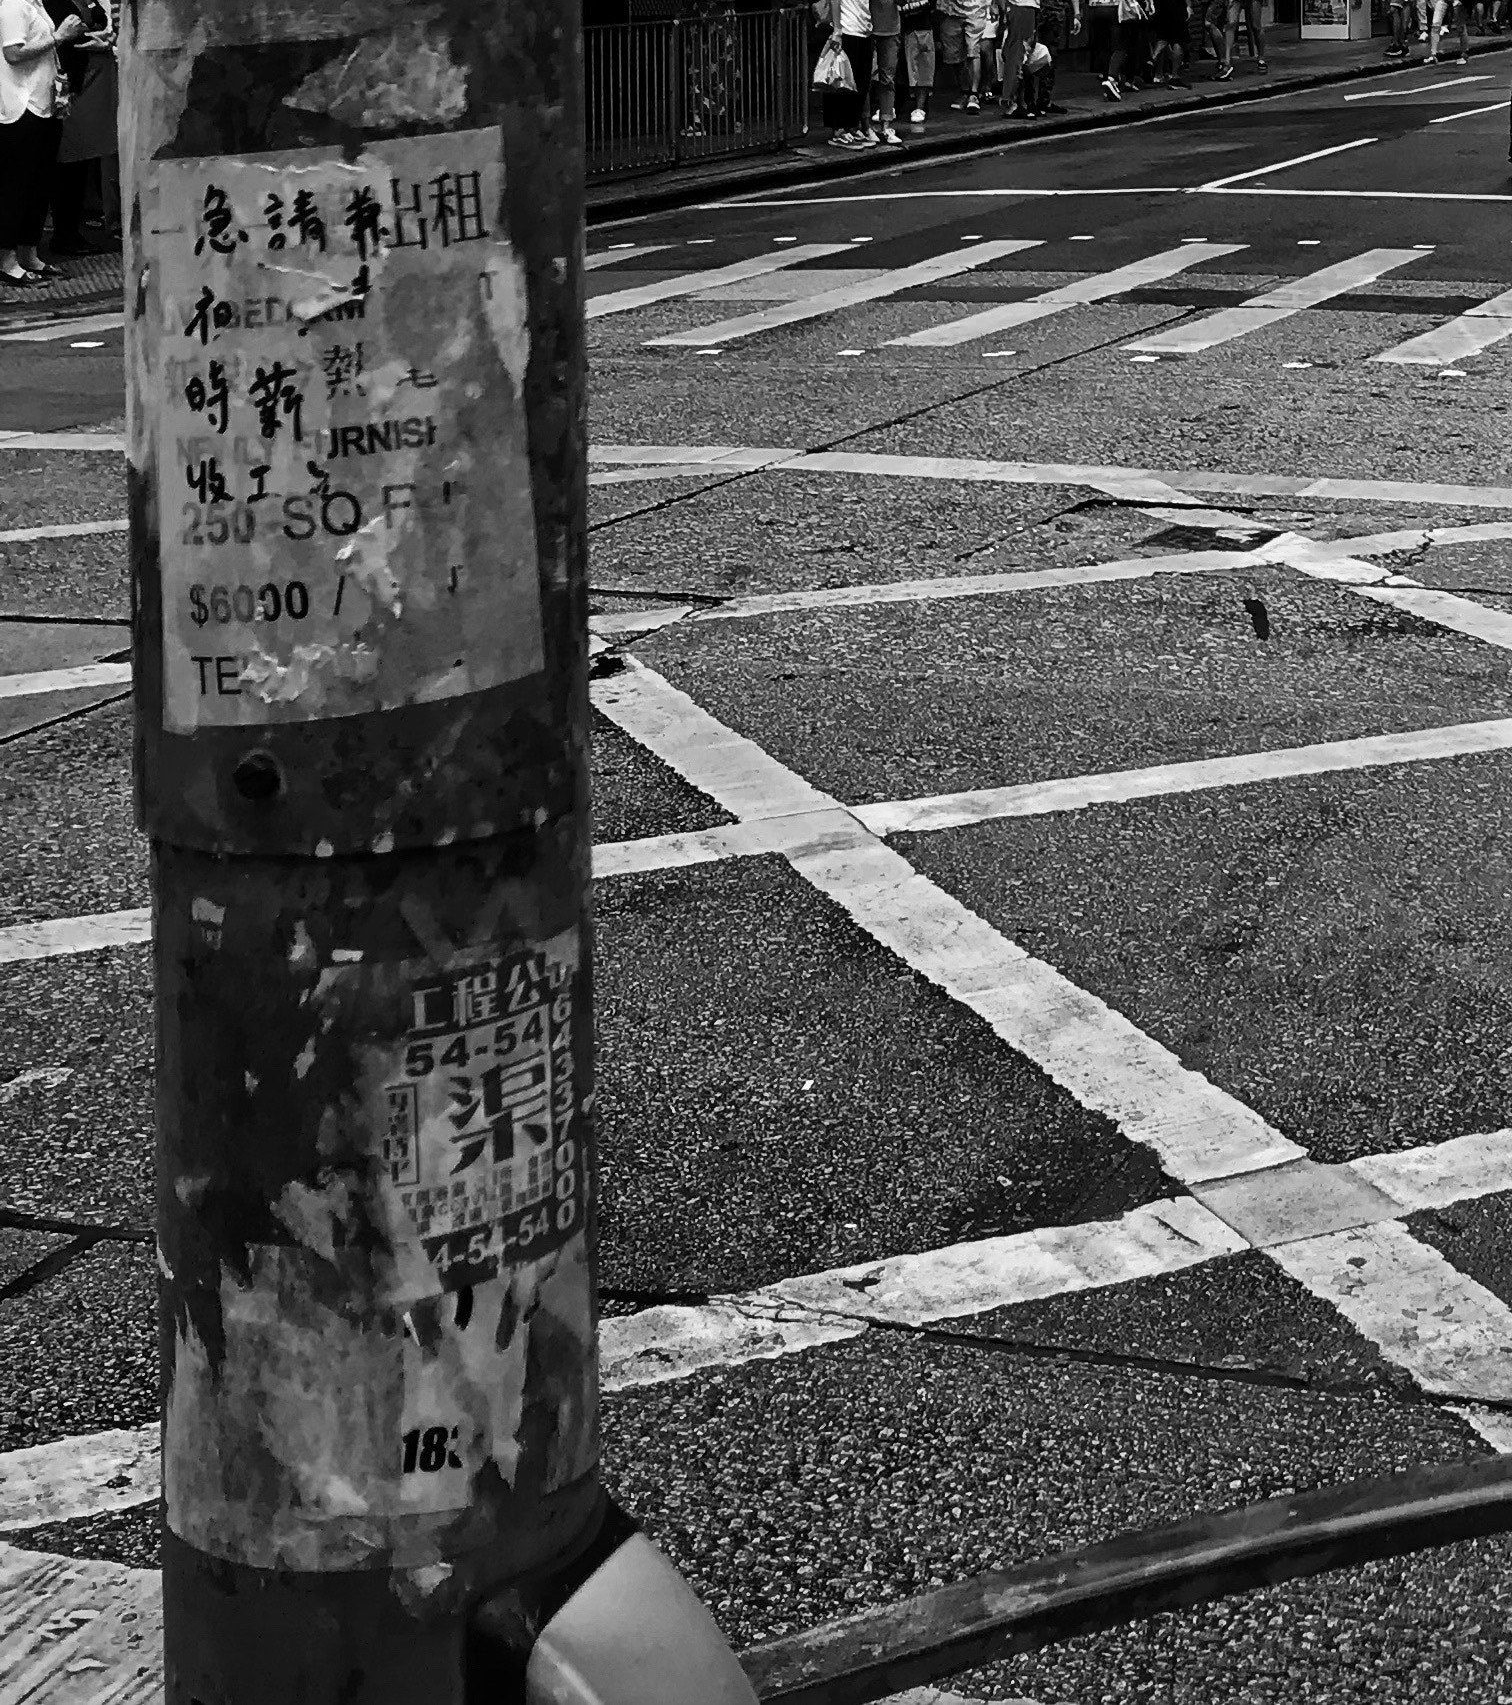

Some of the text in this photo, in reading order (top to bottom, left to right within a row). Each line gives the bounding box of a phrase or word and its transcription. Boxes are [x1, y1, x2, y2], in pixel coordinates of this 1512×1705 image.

[282, 491, 363, 541] SQ
[189, 580, 309, 629] $6000
[190, 655, 245, 696] TE
